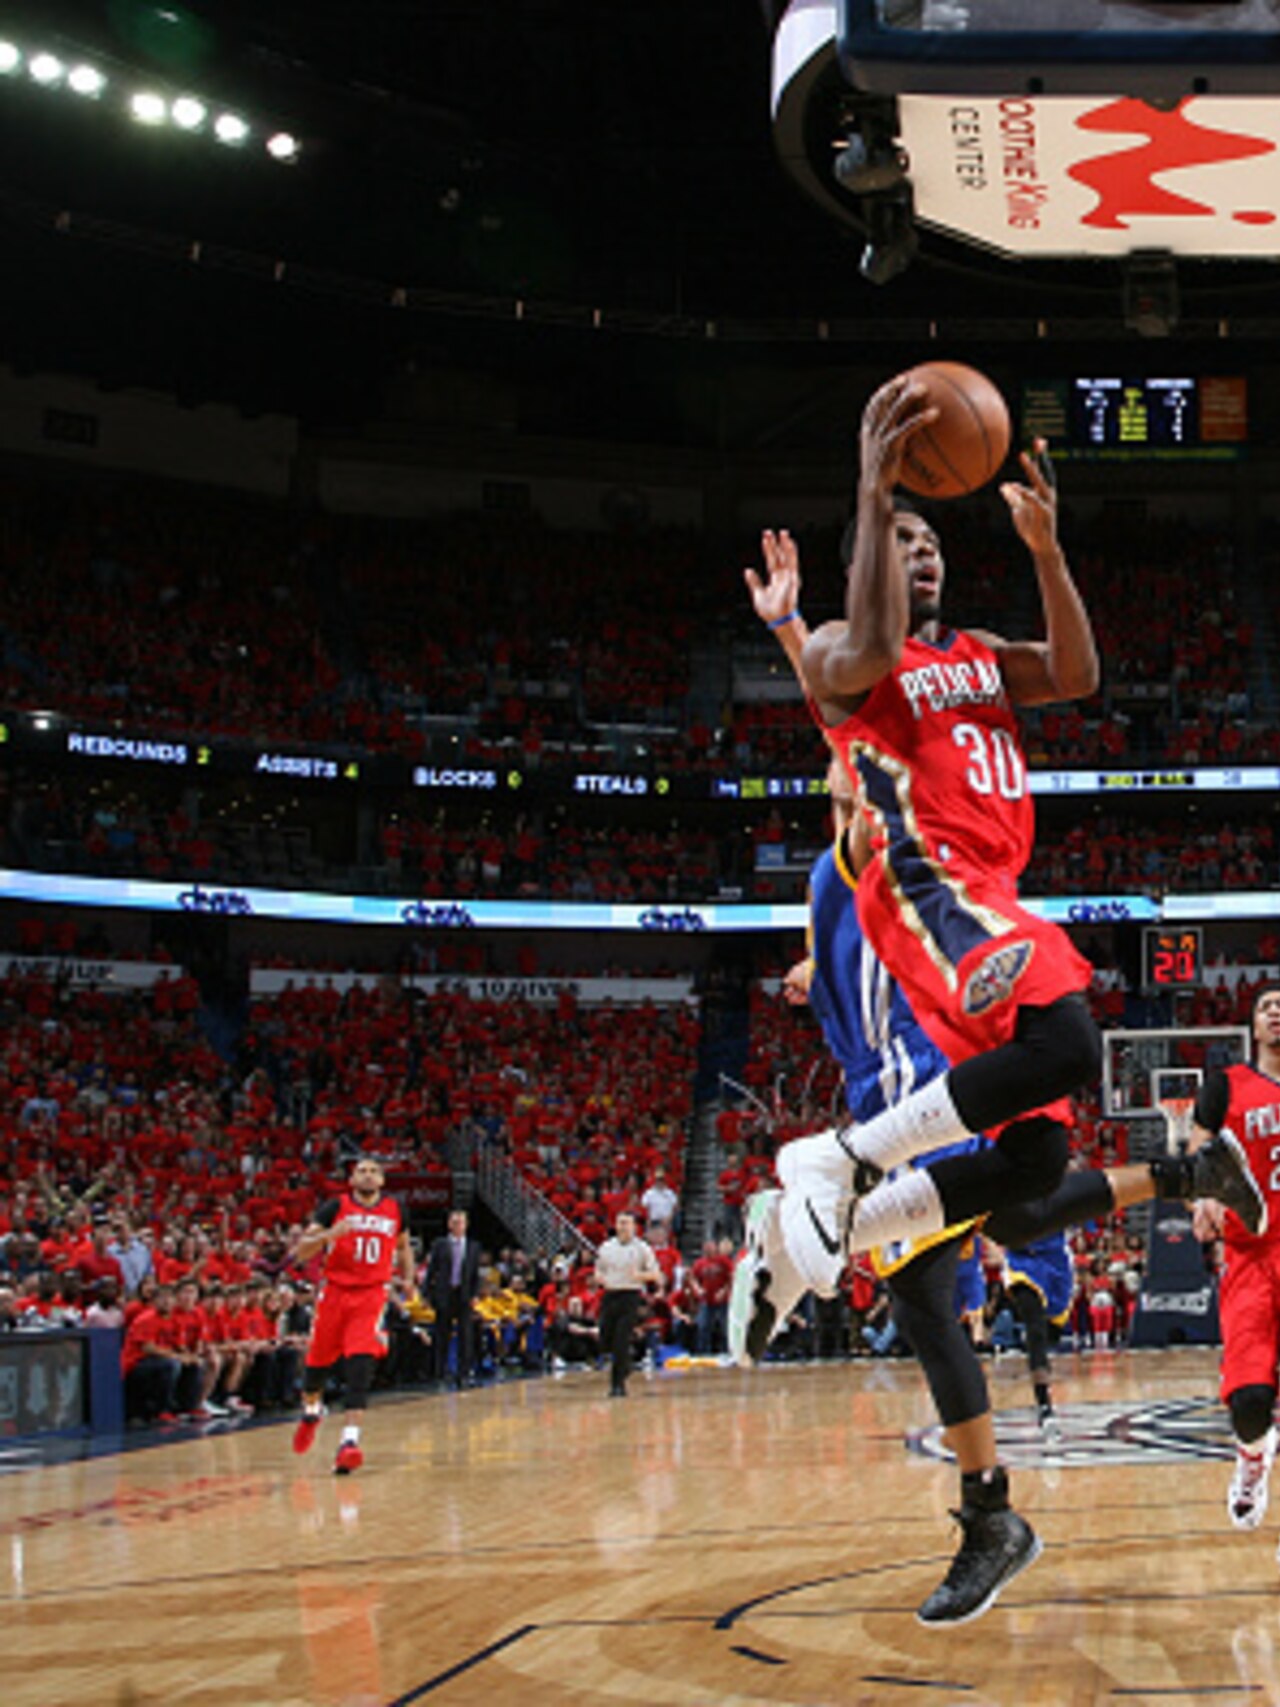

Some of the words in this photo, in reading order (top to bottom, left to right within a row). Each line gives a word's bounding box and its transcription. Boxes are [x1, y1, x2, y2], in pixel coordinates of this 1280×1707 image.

[949, 106, 988, 190] CENTER
[68, 732, 187, 764] REBOUNDS
[952, 722, 1025, 801] 30
[256, 753, 337, 779] ASSISTS
[414, 766, 497, 788] BLOCKS
[574, 775, 647, 794] STEALS
[1154, 951, 1195, 983] 20
[353, 1236, 381, 1264] 10
